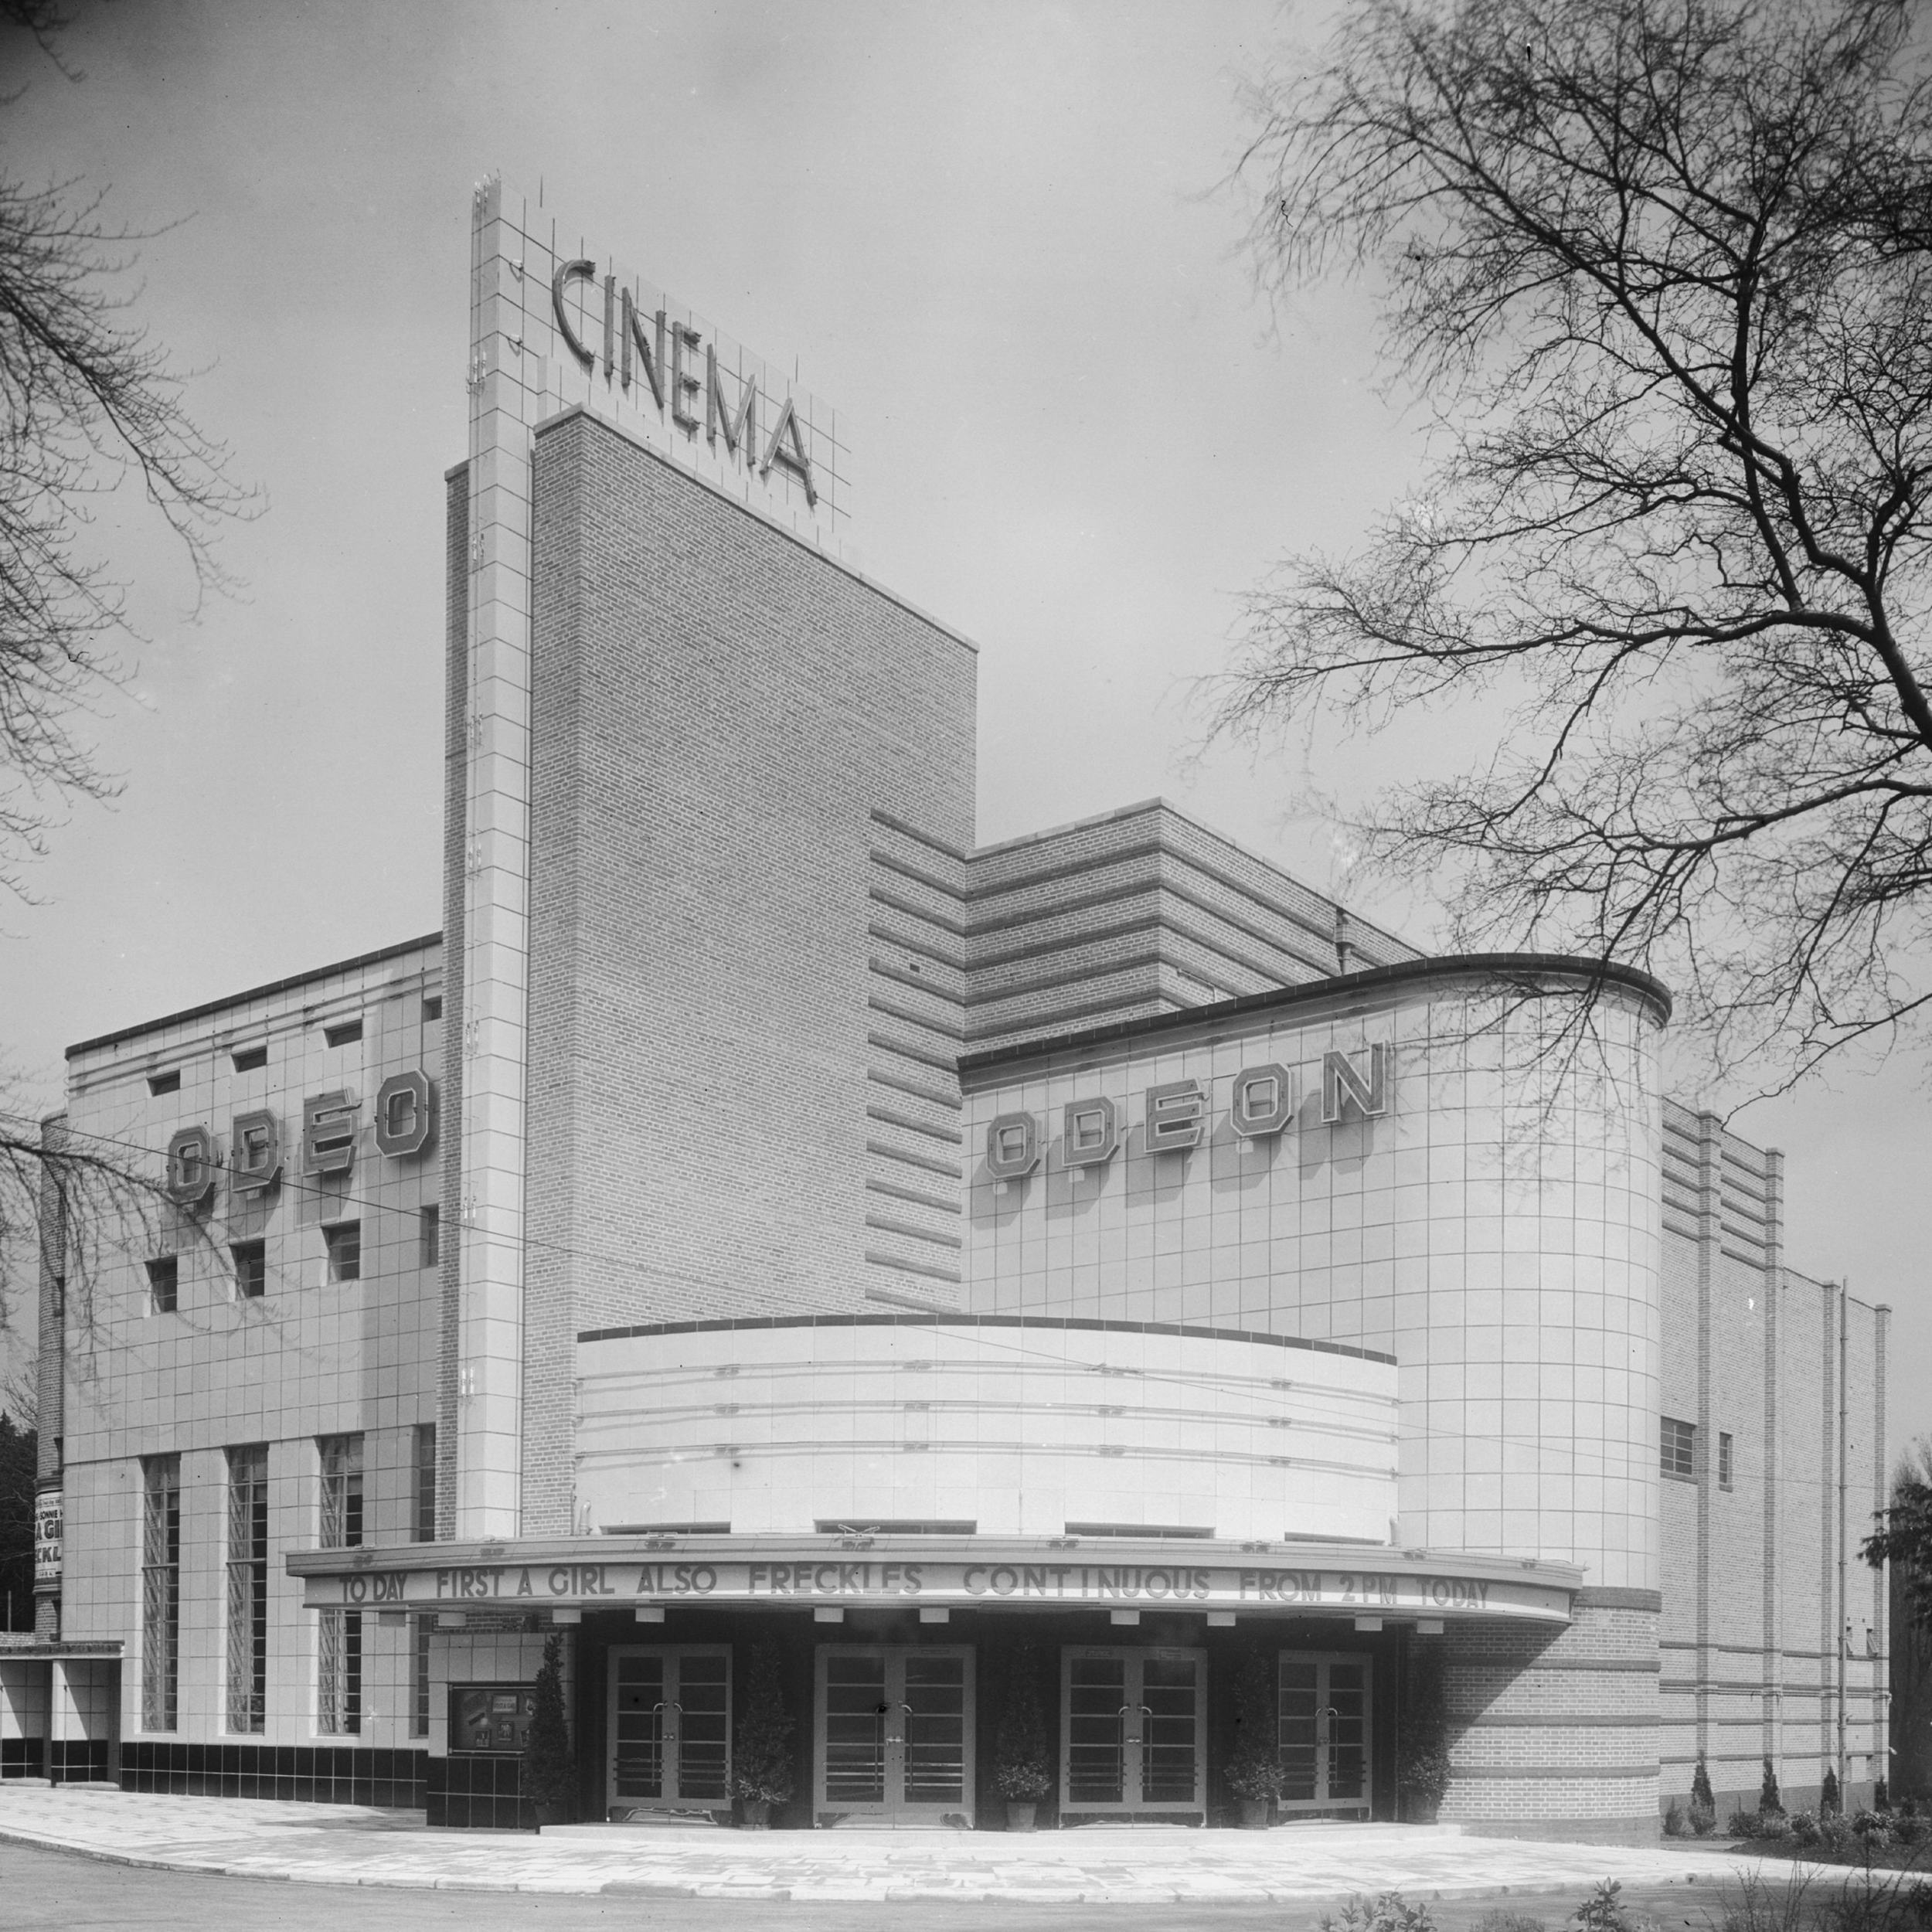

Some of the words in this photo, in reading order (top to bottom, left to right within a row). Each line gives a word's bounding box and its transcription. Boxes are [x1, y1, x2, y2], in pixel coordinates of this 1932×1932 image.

[552, 258, 818, 507] CINEMA
[987, 1040, 1389, 1178] ODEON
[437, 1569, 504, 1598] FIRST
[517, 1568, 533, 1596] A
[548, 1566, 615, 1595] GIRL
[636, 1565, 717, 1594] ALSO
[749, 1564, 923, 1594] FRECKLES
[963, 1564, 1212, 1599] CONTINUOUS
[1239, 1570, 1321, 1601] FROM
[1415, 1577, 1489, 1608] TODAY
